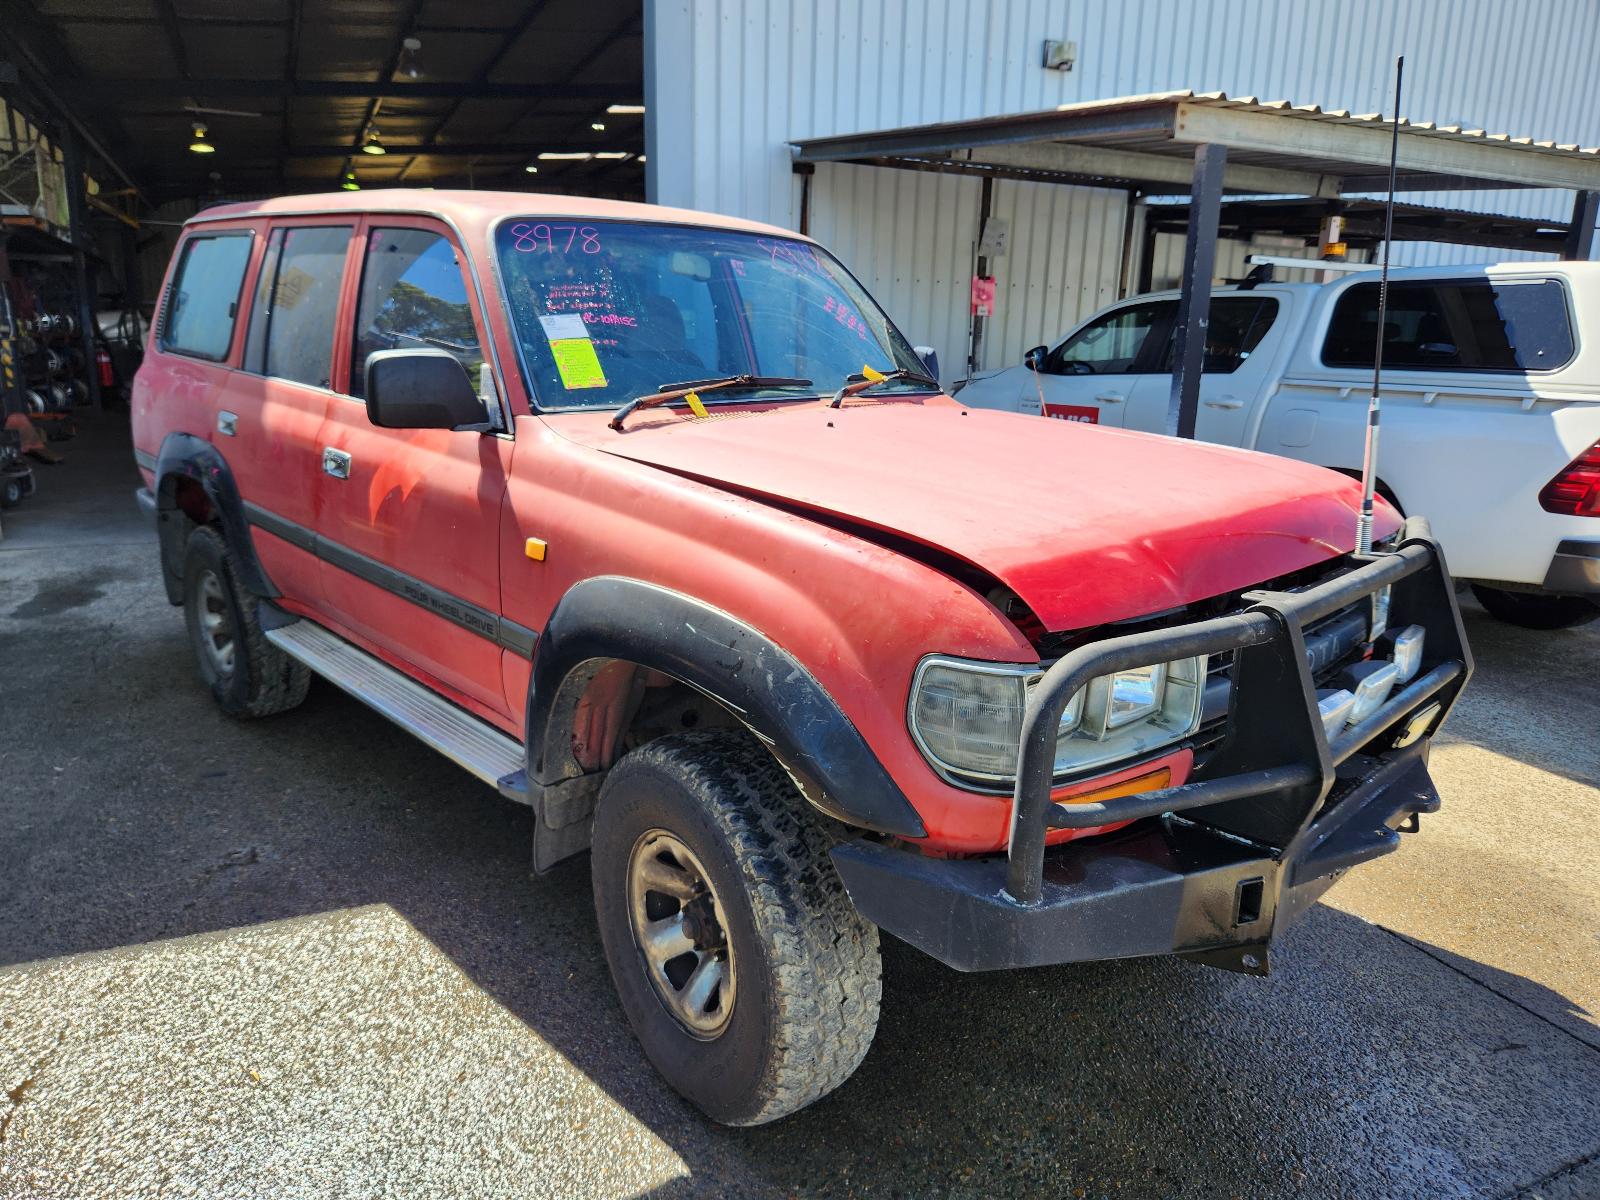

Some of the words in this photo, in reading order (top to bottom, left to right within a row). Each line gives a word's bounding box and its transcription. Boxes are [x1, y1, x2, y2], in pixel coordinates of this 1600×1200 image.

[511, 223, 600, 254] 8978
[405, 586, 429, 602] FOUR
[431, 599, 463, 620] WHEEL
[465, 613, 494, 634] DRIVE
